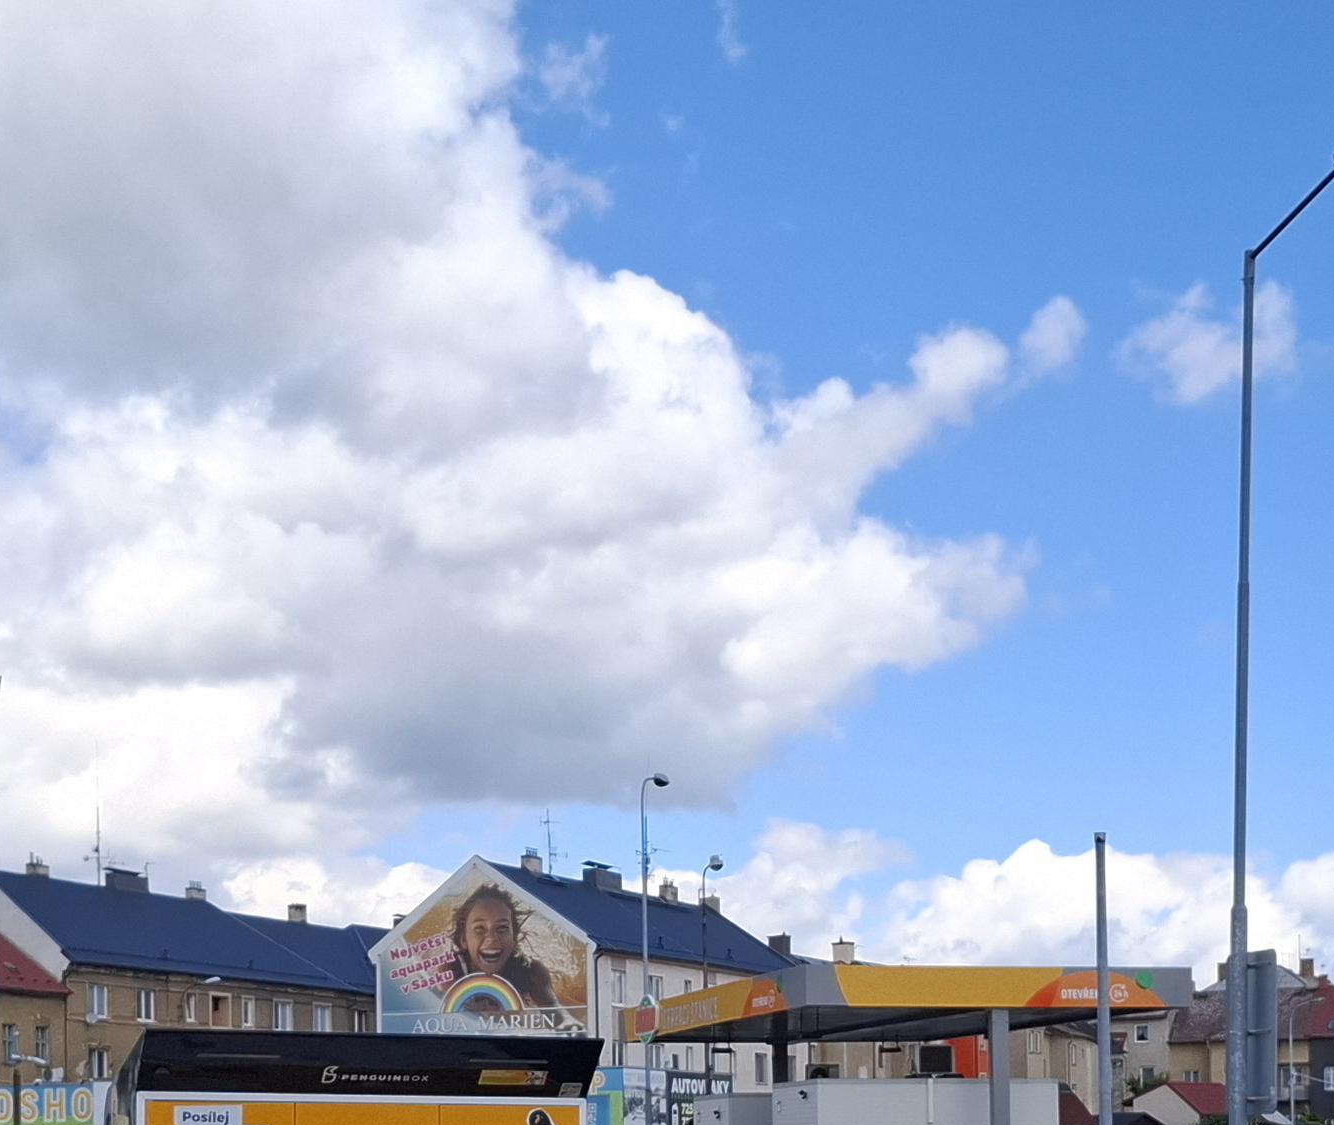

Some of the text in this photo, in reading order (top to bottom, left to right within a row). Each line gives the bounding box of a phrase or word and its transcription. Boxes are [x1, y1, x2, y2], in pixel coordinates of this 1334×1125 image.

[390, 951, 456, 980] aquapark
[412, 970, 454, 991] Sasku
[412, 1013, 556, 1034] AQUA MARIEN
[341, 1073, 430, 1083] PENGUINBOX
[671, 1077, 730, 1095] AUTOVAKY
[182, 1110, 230, 1125] Posílej
